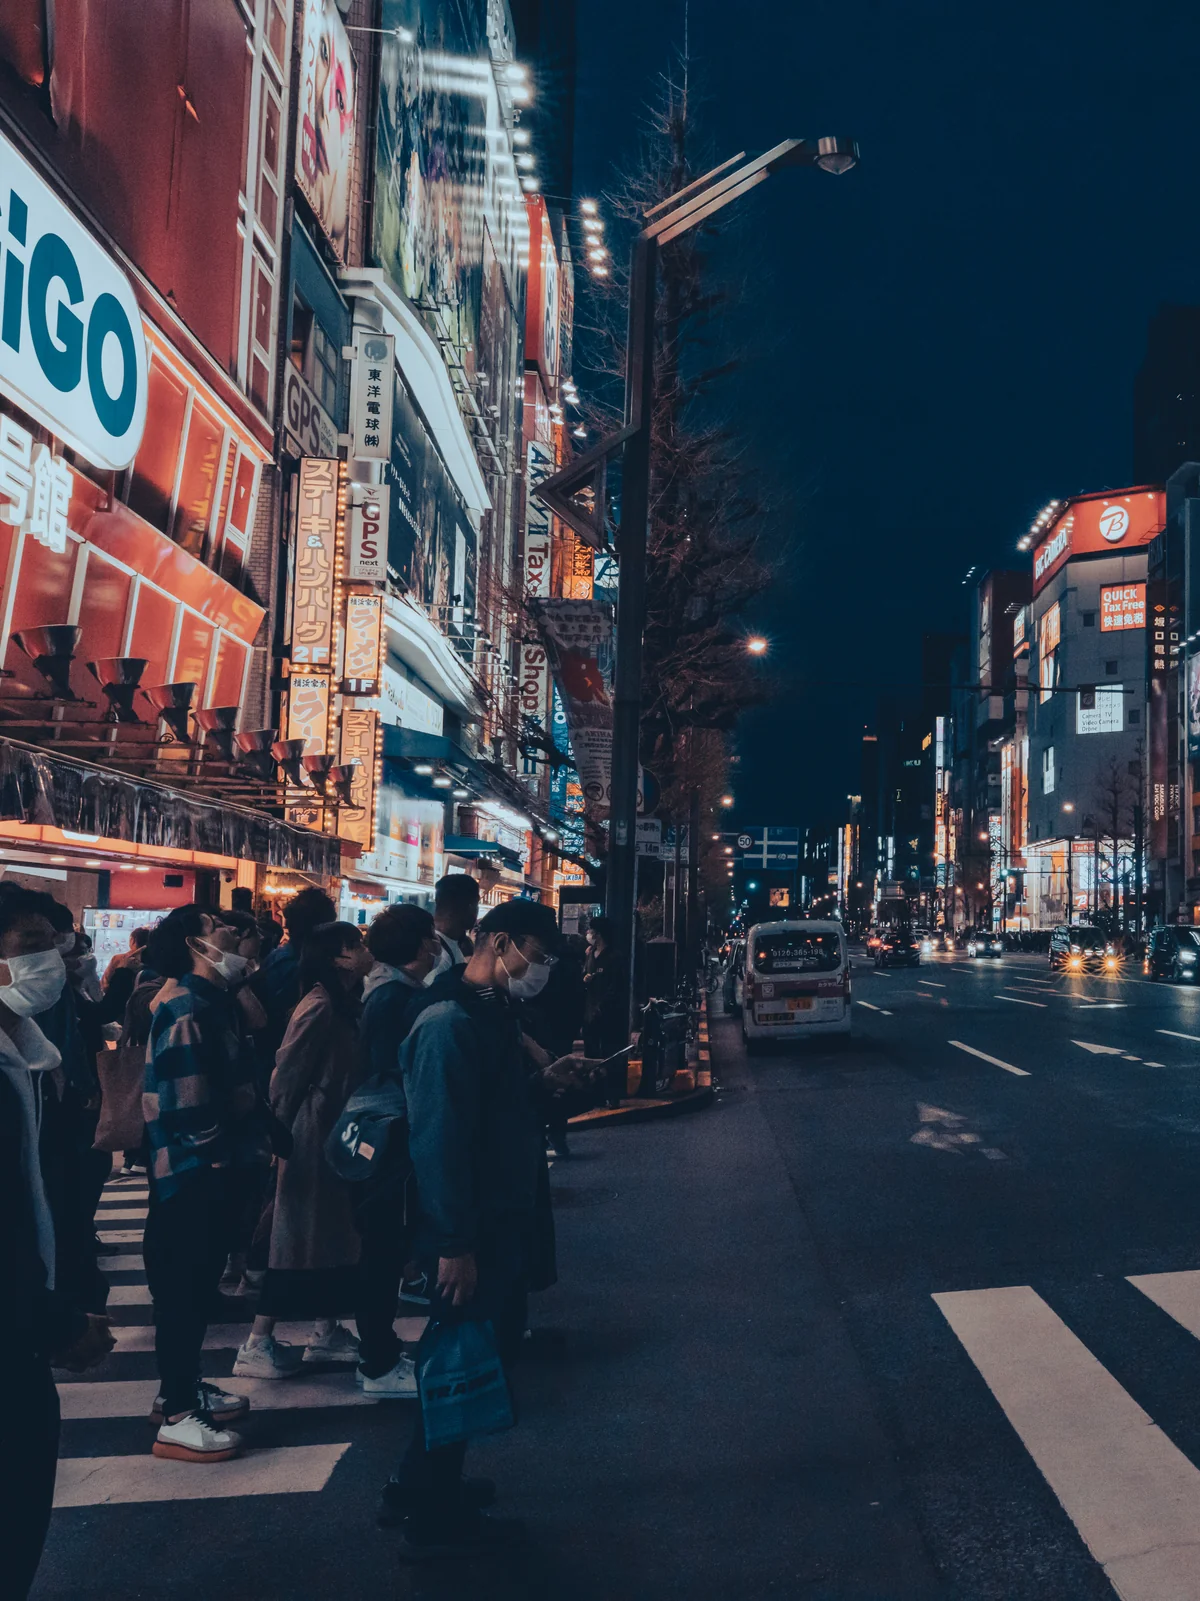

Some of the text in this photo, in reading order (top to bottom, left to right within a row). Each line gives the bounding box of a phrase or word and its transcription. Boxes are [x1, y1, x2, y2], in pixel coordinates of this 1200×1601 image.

[0, 185, 138, 438] iGO
[288, 374, 320, 456] GPS
[361, 502, 381, 559] GPS
[297, 459, 333, 645] ステーキ&ハンバーグ
[1103, 588, 1137, 603] QUICK
[1103, 600, 1145, 612] Tax Free
[1103, 612, 1144, 628] 快速免税
[348, 607, 377, 677] ラーメン
[293, 646, 328, 663] 2F
[347, 678, 375, 693] 1F
[522, 648, 547, 712] Shop
[1082, 712, 1101, 720] Camera
[1098, 718, 1119, 726] Camera
[739, 837, 751, 846] 50
